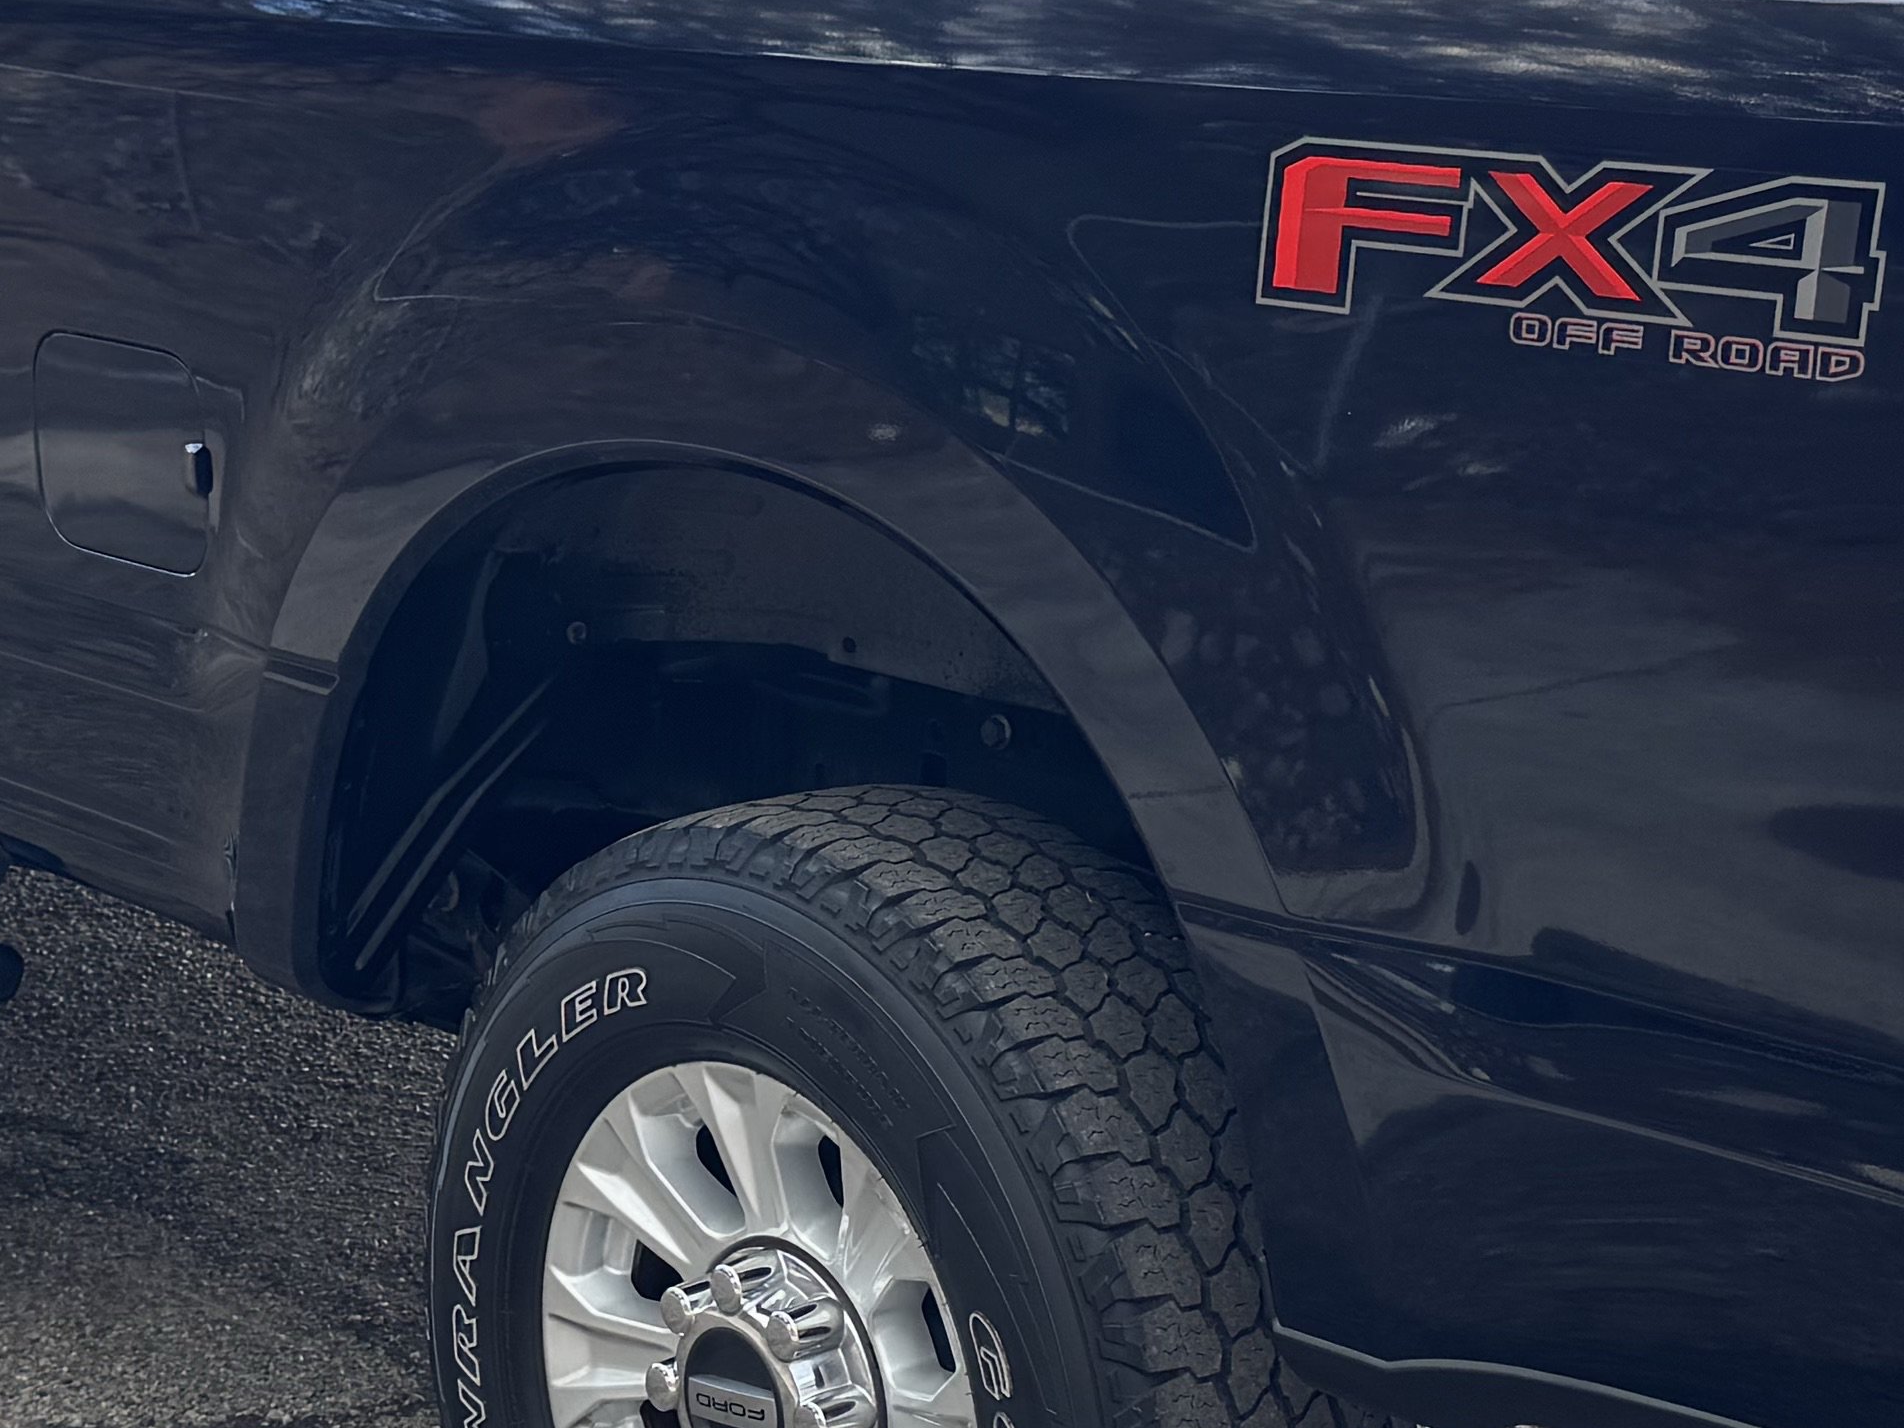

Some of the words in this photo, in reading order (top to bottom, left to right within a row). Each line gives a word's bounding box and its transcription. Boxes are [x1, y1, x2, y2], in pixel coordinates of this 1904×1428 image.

[1256, 136, 1886, 346] FX4
[1509, 312, 1643, 355] OFF
[1668, 328, 1866, 383] ROAD
[696, 1392, 766, 1422] FORD
